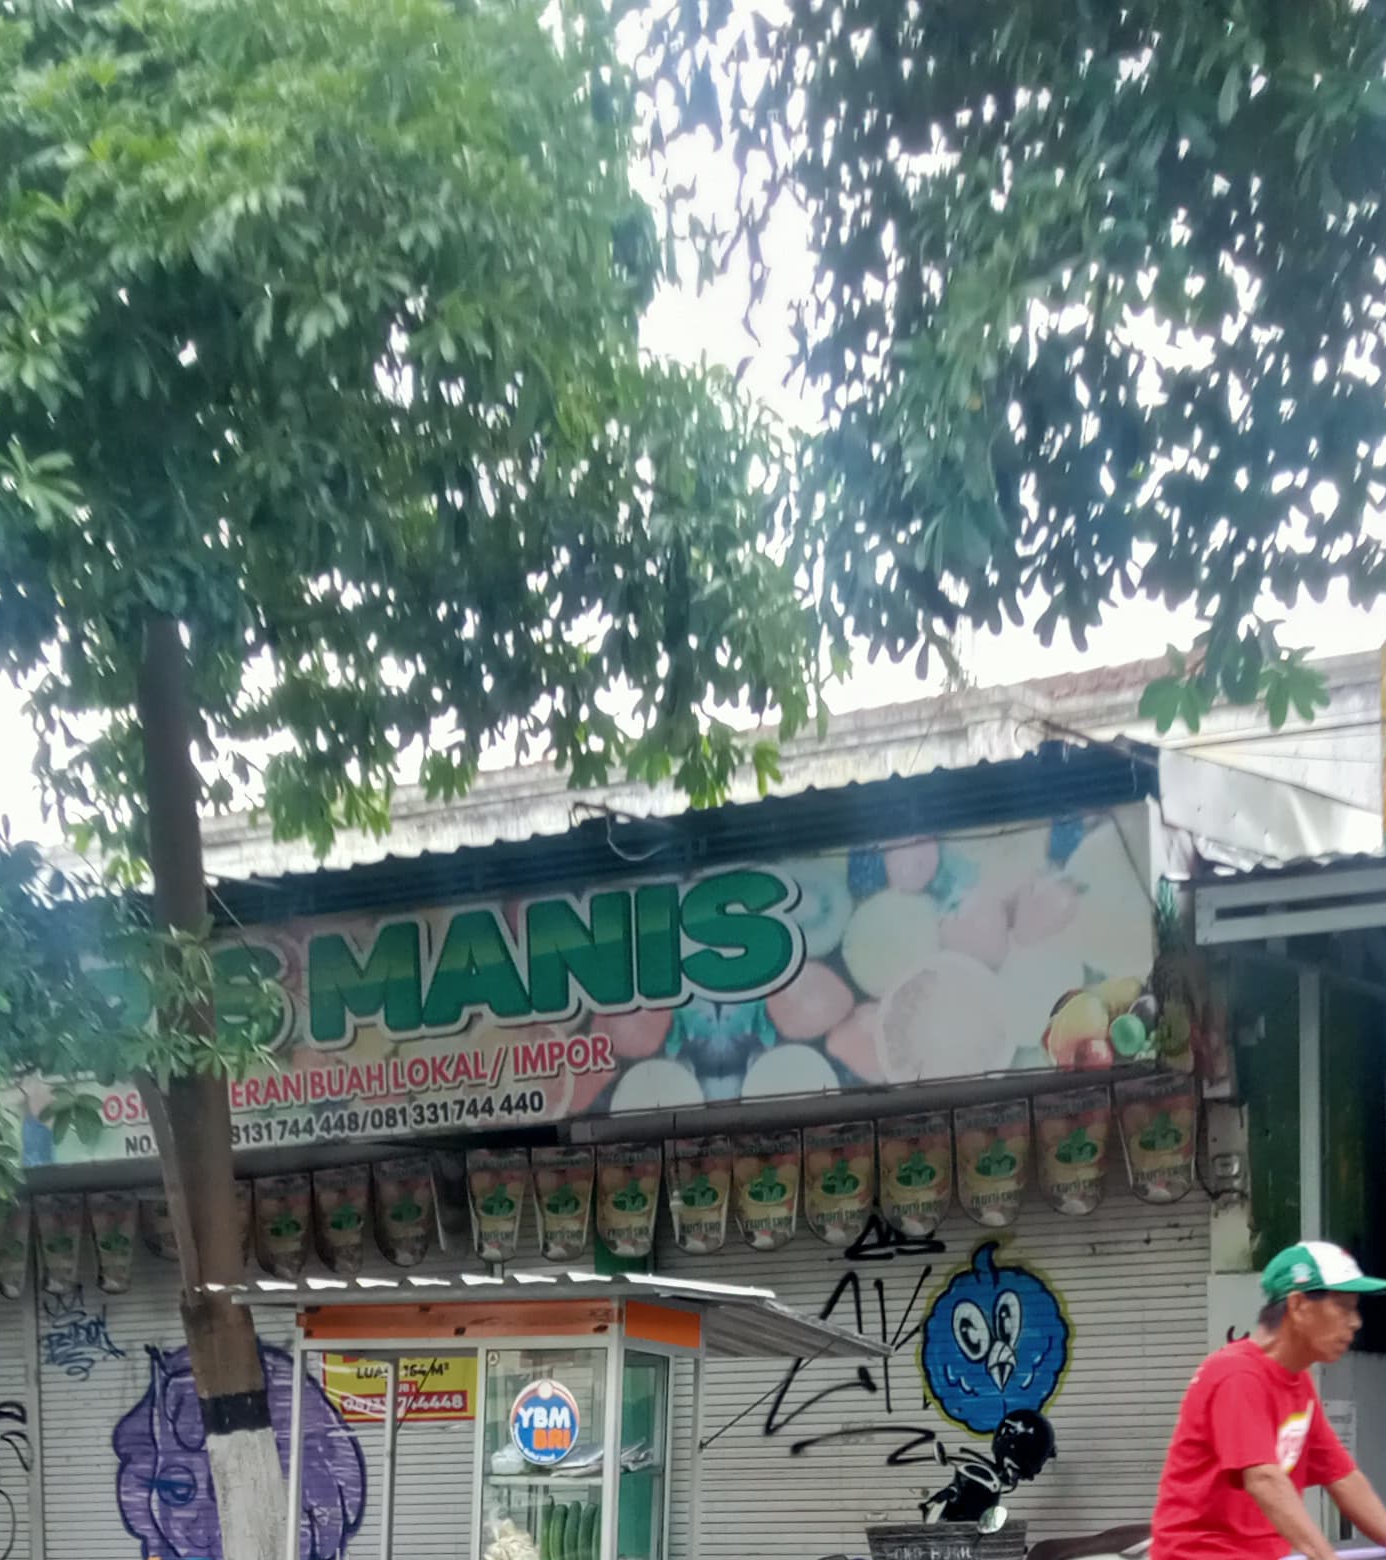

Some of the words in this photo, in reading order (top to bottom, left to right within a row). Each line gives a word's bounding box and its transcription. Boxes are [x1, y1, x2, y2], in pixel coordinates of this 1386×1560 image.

[306, 868, 795, 1042] MANIS
[310, 1063, 385, 1099] BUAH
[513, 1035, 613, 1076] IMPOR
[518, 1406, 571, 1429] YBM
